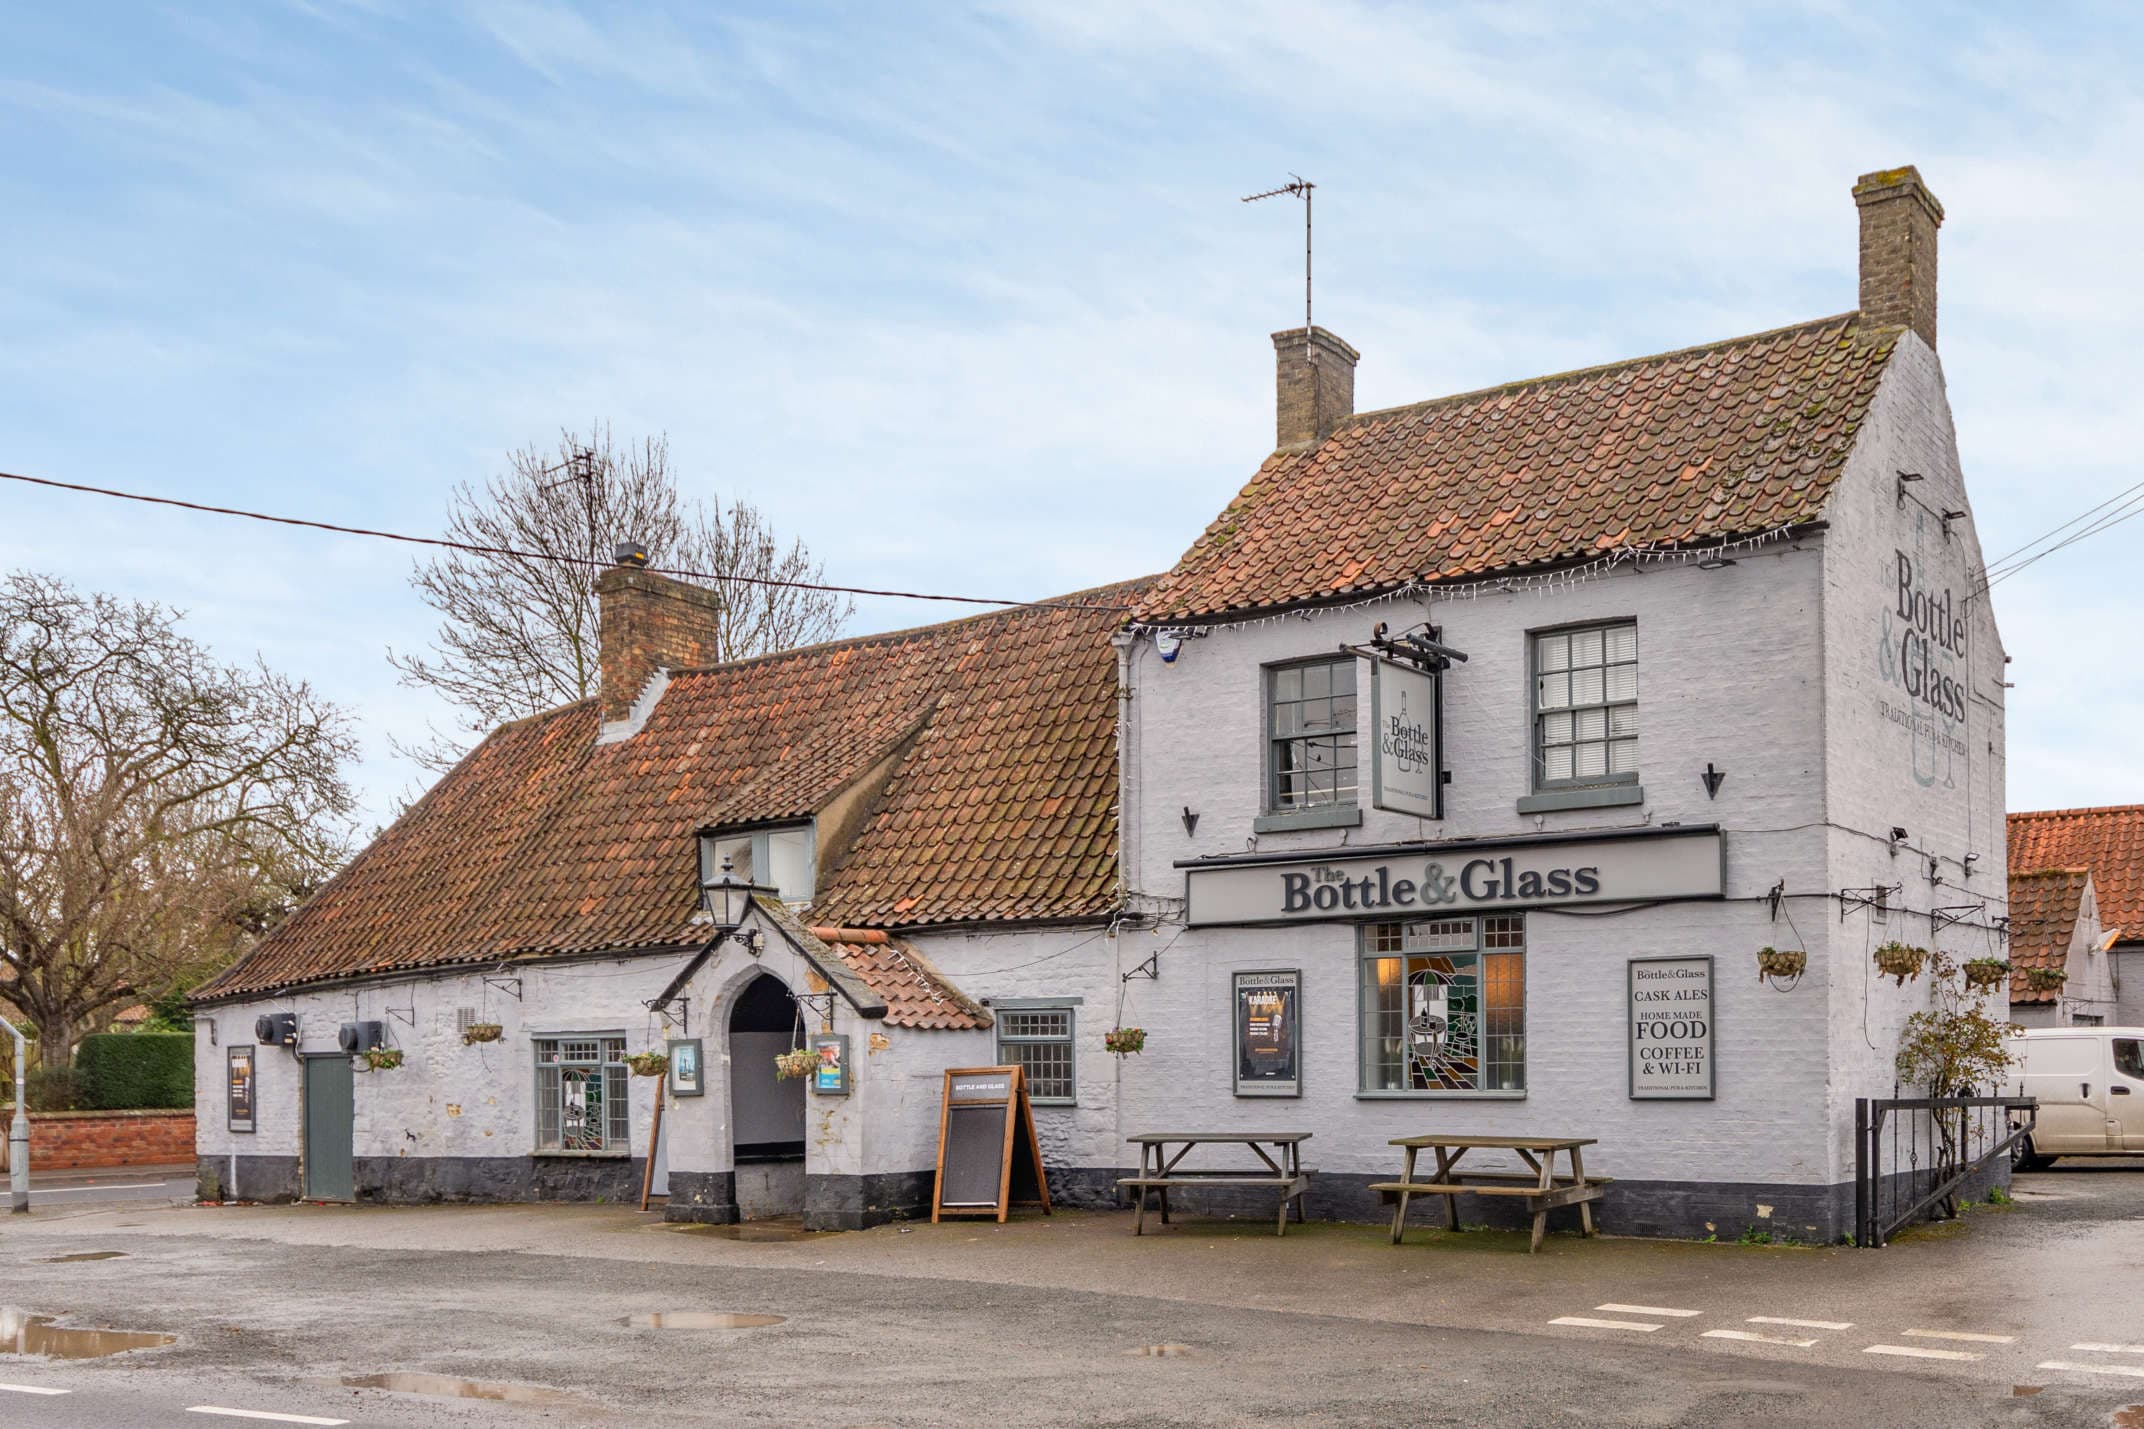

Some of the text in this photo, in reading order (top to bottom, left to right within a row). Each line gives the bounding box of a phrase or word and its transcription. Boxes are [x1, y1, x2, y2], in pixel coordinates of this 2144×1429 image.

[1895, 548, 1965, 659] Bottle
[1391, 715, 1429, 745] Bottle
[1311, 866, 1346, 883] The
[1634, 989, 1708, 1002] CASK ALES
[1640, 1010, 1703, 1020] HOME MADE
[1635, 1020, 1707, 1040] FOOD
[1640, 1046, 1705, 1060] COFFEE
[1642, 1061, 1701, 1075] & WI-FI
